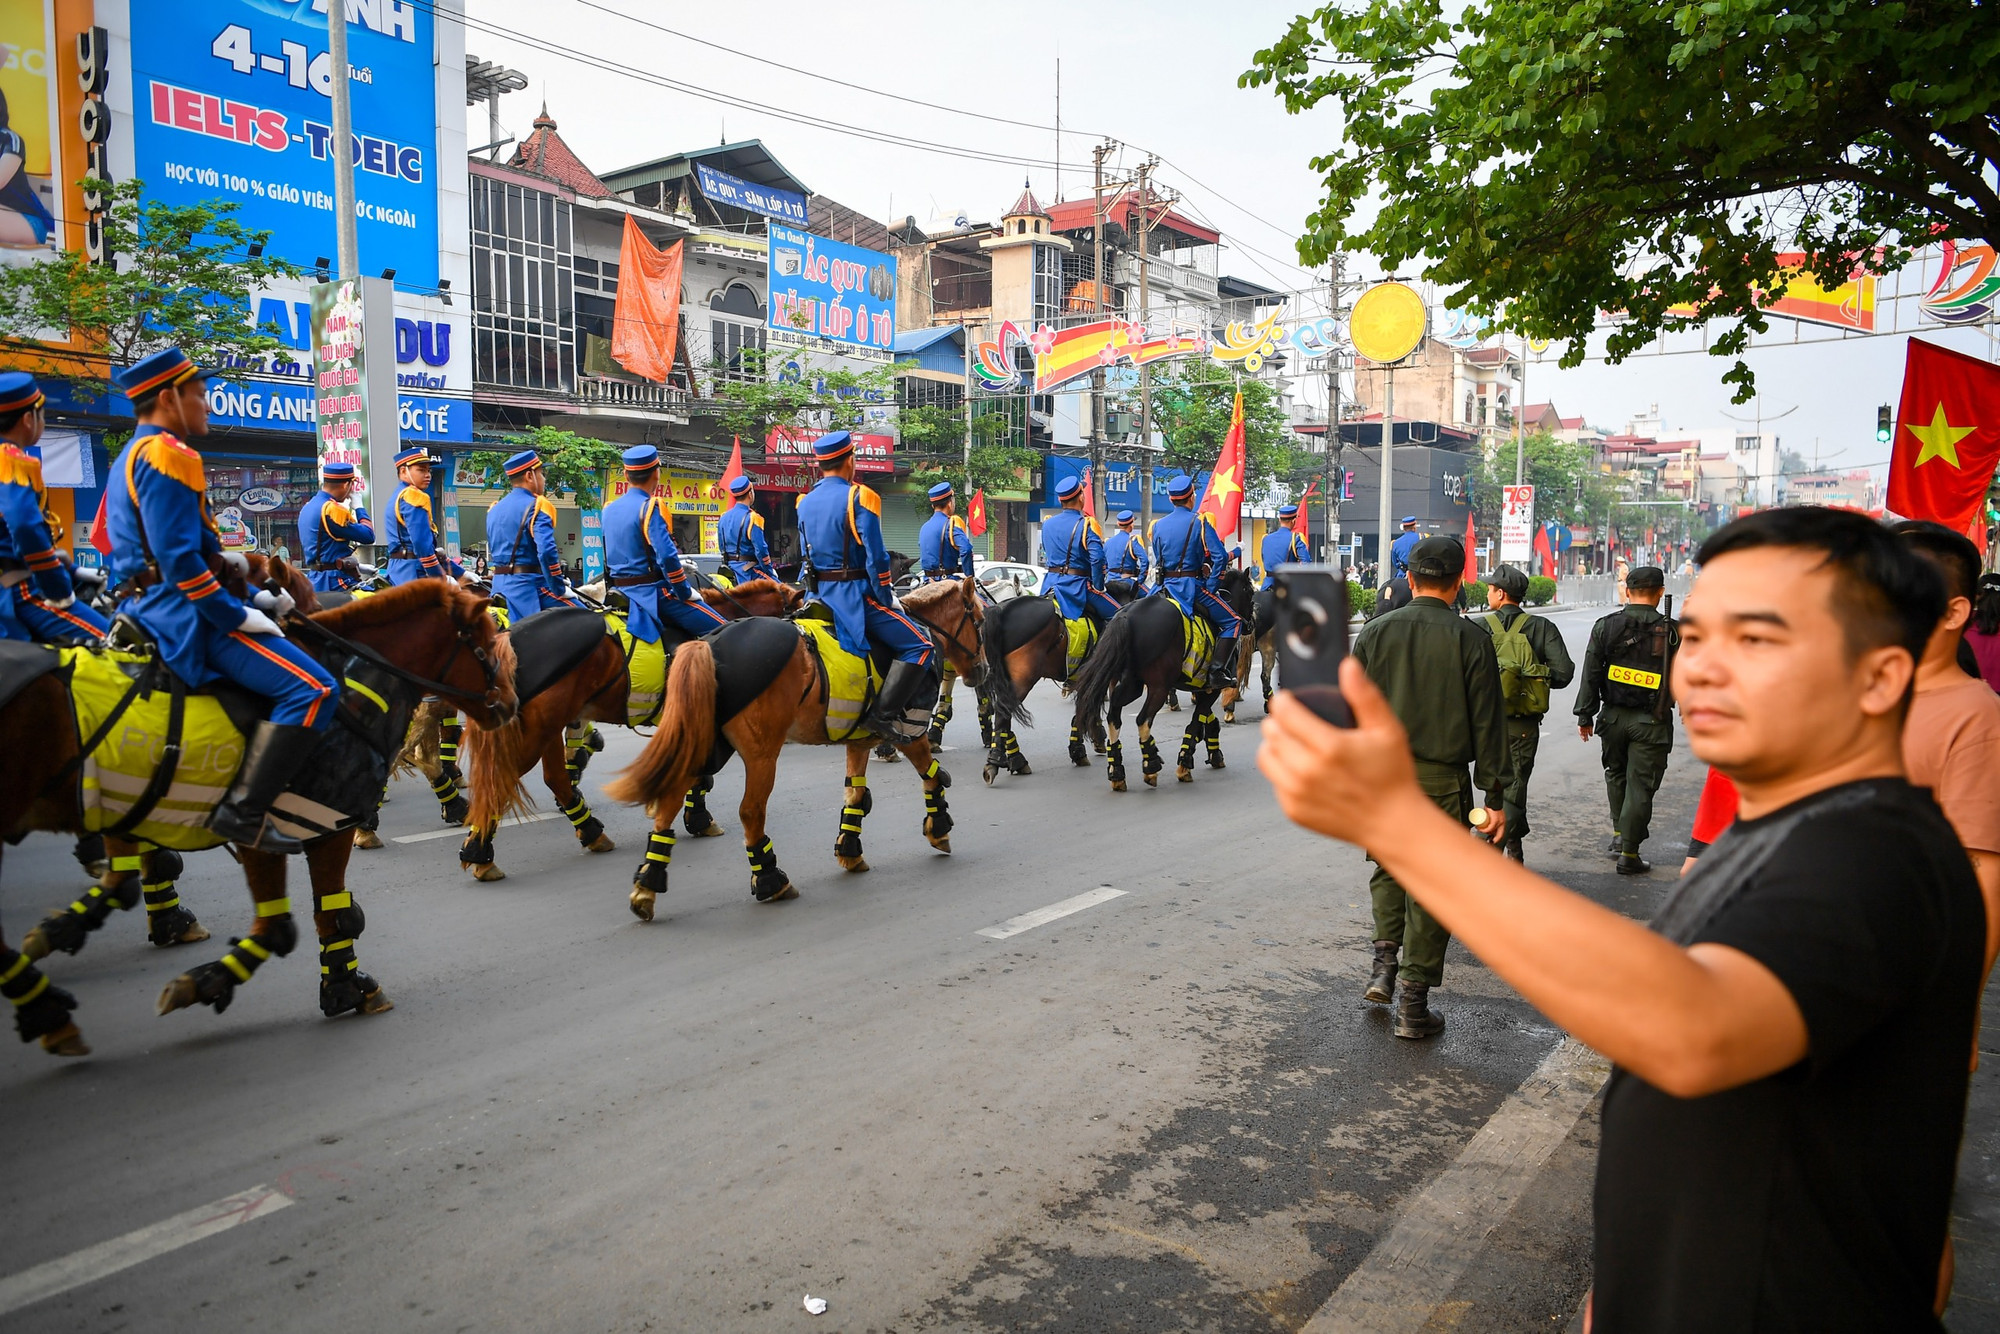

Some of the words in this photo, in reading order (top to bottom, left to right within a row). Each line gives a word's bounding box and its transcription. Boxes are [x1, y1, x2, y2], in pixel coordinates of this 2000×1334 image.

[165, 161, 195, 185] HỌC
[196, 163, 220, 189] VỚI
[222, 173, 249, 195] 100
[267, 181, 300, 205] GIÁO
[302, 185, 333, 211] VIÊN
[355, 199, 374, 220] ỚC
[376, 206, 416, 229] NGOÀI
[719, 182, 738, 200] QUY
[765, 195, 782, 213] LỐP
[791, 202, 804, 219] TÔ
[772, 226, 785, 241] Vân
[787, 230, 805, 246] Oanh
[831, 258, 867, 294] QUY
[820, 295, 852, 338] LỐP
[856, 304, 869, 343] Ô
[871, 307, 892, 346] TÔ
[335, 341, 355, 362] LỊCH
[395, 318, 451, 366] DU
[271, 359, 301, 376] on
[319, 368, 344, 391] QUỐC
[344, 367, 360, 385] GIA
[205, 382, 262, 418] ỐNG
[267, 395, 317, 422] ANH
[400, 401, 424, 431] ỐC
[426, 404, 450, 433] TẾ
[319, 395, 341, 418] ĐIỆN
[340, 392, 362, 413] BIÊN
[321, 422, 335, 441] VÀ
[347, 421, 362, 443] HỘI
[343, 448, 362, 466] BAN
[651, 480, 673, 498] HẢ
[683, 483, 700, 499] CÁ
[709, 481, 725, 500] ỐC
[1106, 471, 1128, 492] TH
[696, 503, 705, 512] VỊT
[706, 504, 719, 513] LỘN
[586, 552, 600, 567] CÁ
